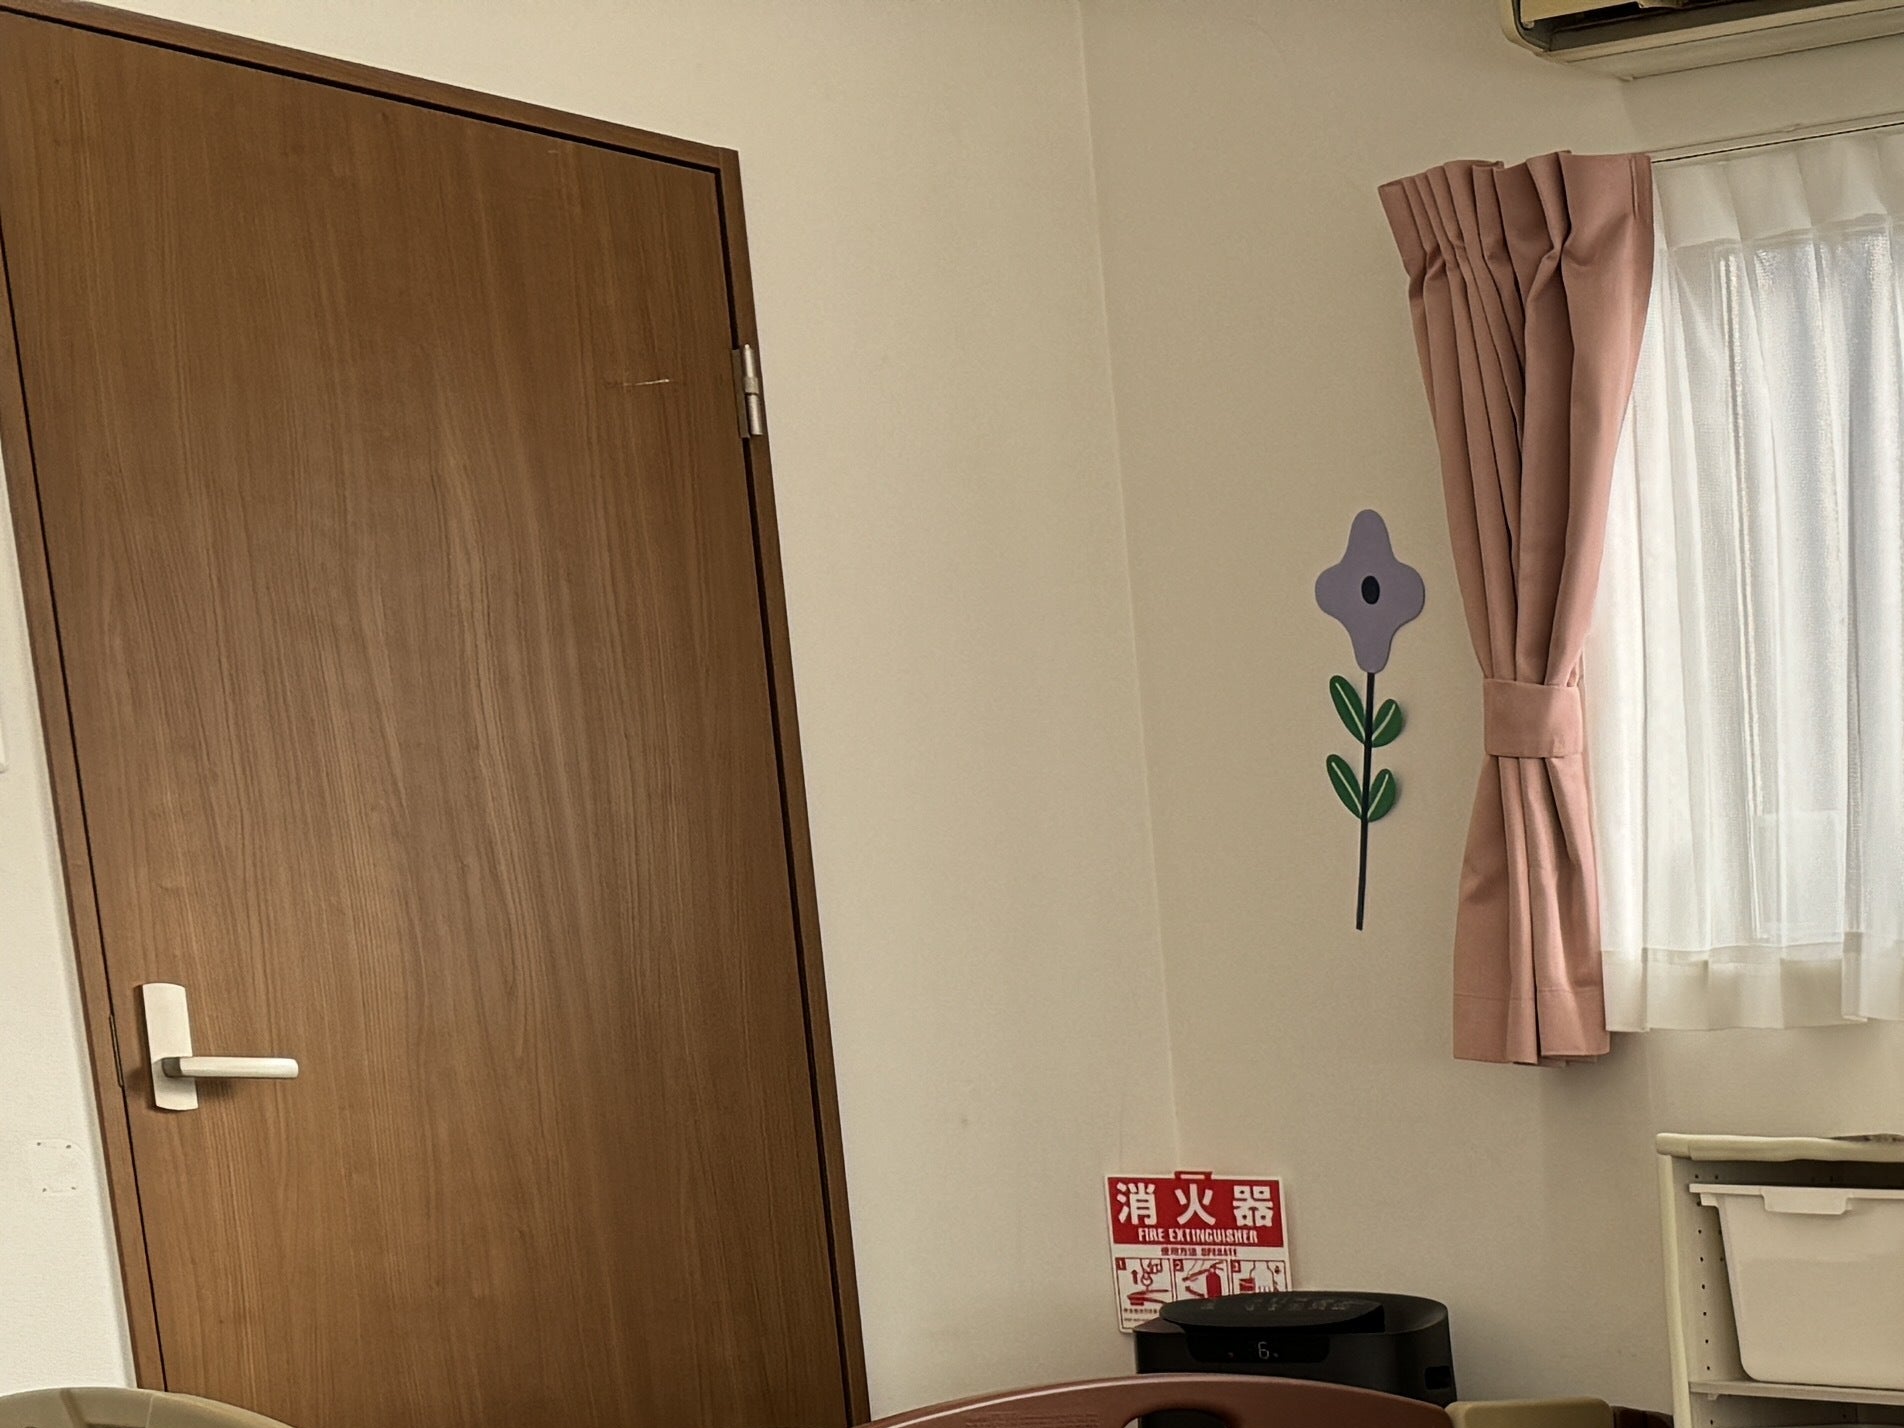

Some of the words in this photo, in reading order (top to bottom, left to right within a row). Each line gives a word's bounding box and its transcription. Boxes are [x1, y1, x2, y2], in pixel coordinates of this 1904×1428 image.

[1116, 1181, 1274, 1227] 消火器
[1138, 1227, 1165, 1242] FIRE
[1169, 1228, 1259, 1244] EXTINGUISHER
